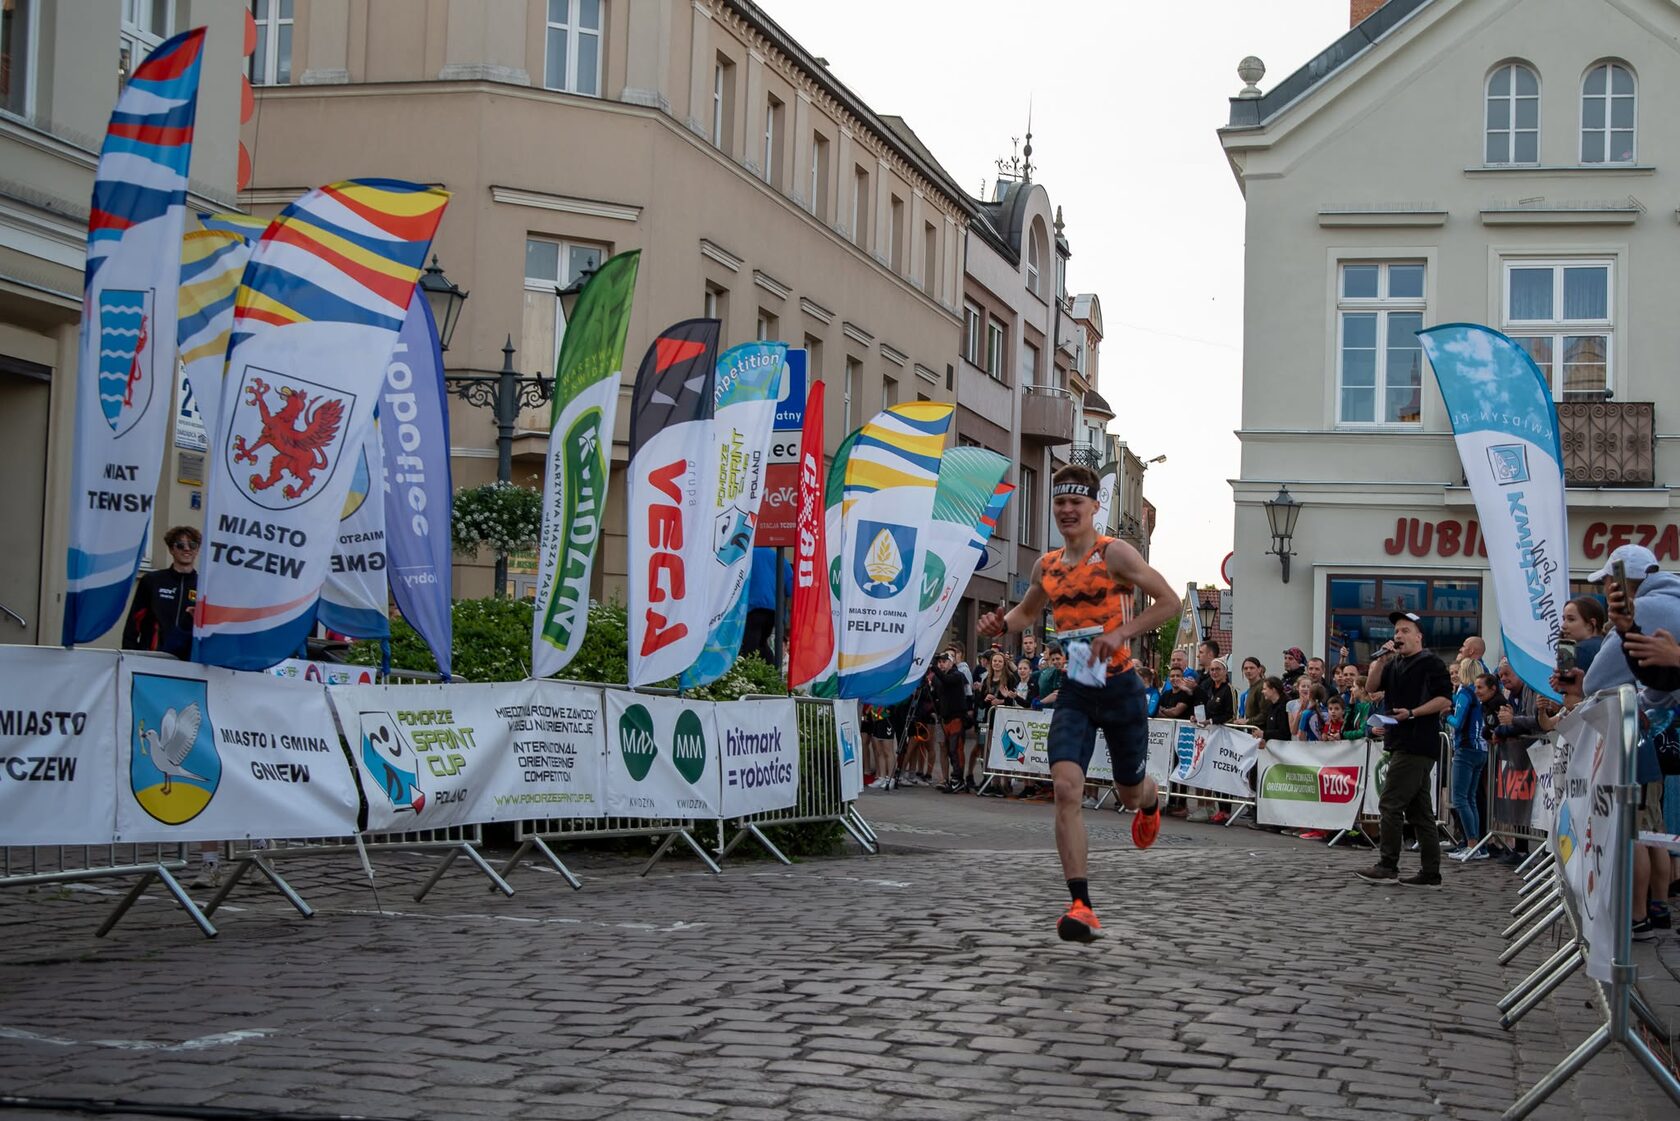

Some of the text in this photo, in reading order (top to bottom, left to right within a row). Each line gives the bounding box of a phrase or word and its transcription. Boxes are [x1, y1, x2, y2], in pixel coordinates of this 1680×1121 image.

[715, 353, 779, 411] mpetition
[776, 411, 802, 422] atny
[750, 450, 761, 500] POLAND
[218, 514, 307, 547] MIASTO
[210, 541, 306, 579] TCZEW
[640, 459, 688, 657] VEGA
[848, 608, 877, 616] MIASTO
[883, 610, 908, 618] GMINA
[847, 620, 905, 634] PELPLIN
[0, 711, 87, 736] MIASTO
[397, 709, 455, 726] POMORZE
[221, 728, 330, 753] MIASTO I GMINA
[411, 727, 477, 752] SPRINT
[676, 734, 703, 759] MM
[726, 726, 781, 757] hitmark
[251, 761, 310, 783] GNIEW
[427, 753, 466, 777] CUP
[740, 757, 792, 789] robotics
[1323, 774, 1350, 795] PZOS
